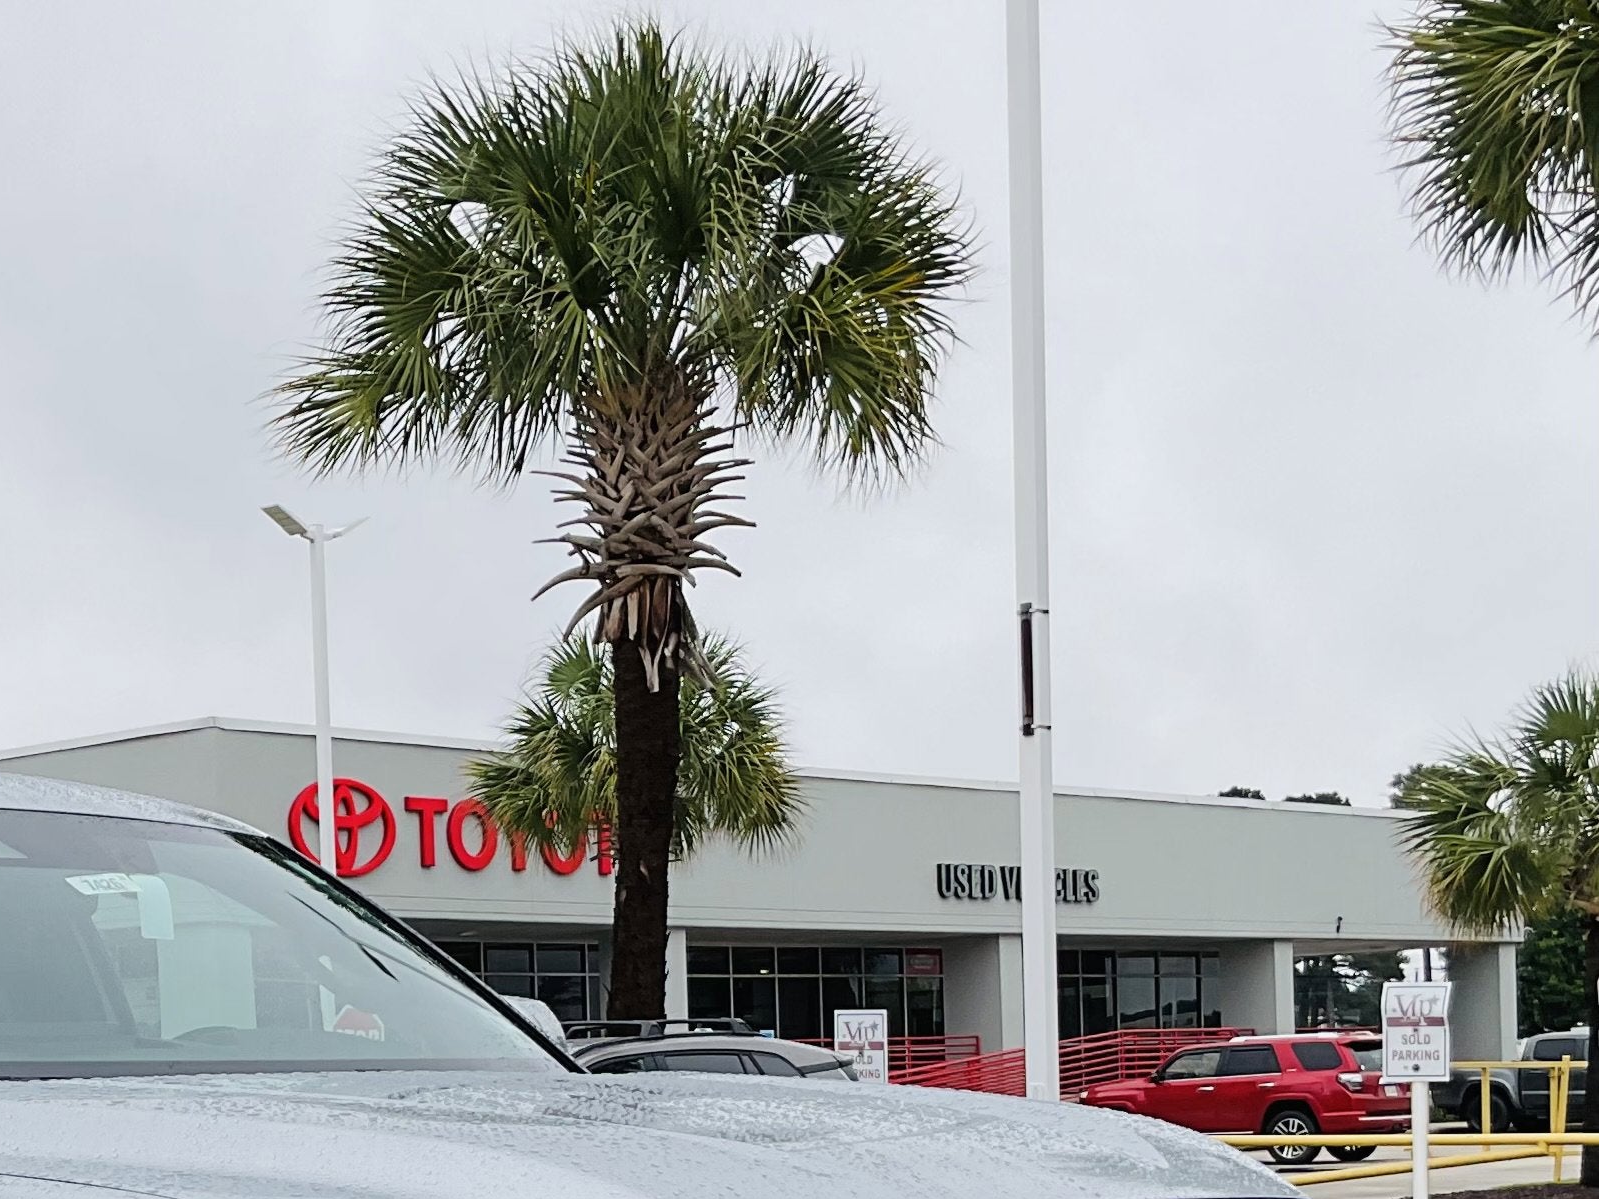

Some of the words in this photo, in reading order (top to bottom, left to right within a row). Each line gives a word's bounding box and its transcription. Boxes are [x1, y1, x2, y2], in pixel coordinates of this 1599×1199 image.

[403, 795, 613, 876] TOYOT
[936, 862, 998, 900] USED
[999, 865, 1100, 904] VCLES
[1401, 1034, 1432, 1046] SOLD
[855, 1055, 874, 1065] OLD
[1392, 1050, 1440, 1061] PARKING
[857, 1069, 881, 1079] KING
